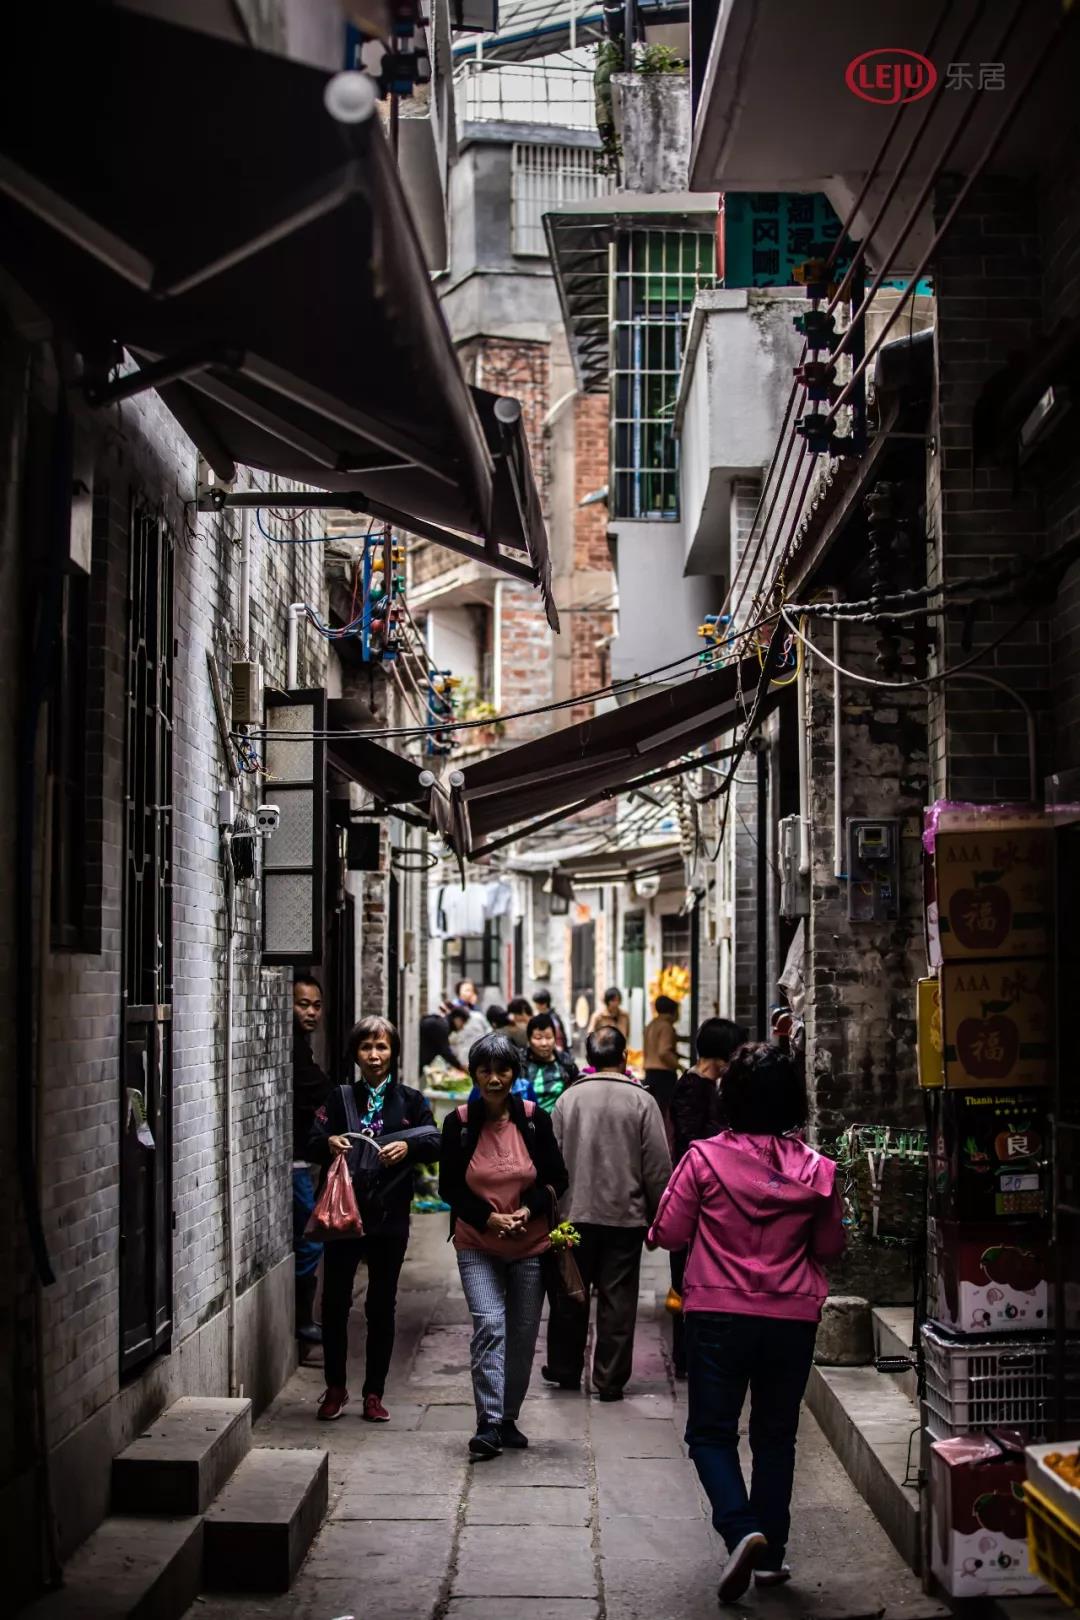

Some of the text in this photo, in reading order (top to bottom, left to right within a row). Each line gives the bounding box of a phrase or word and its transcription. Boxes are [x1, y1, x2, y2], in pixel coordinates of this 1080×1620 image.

[954, 976, 990, 992] AAA
[969, 1032, 1005, 1063] 福
[1007, 1135, 1031, 1157] 良
